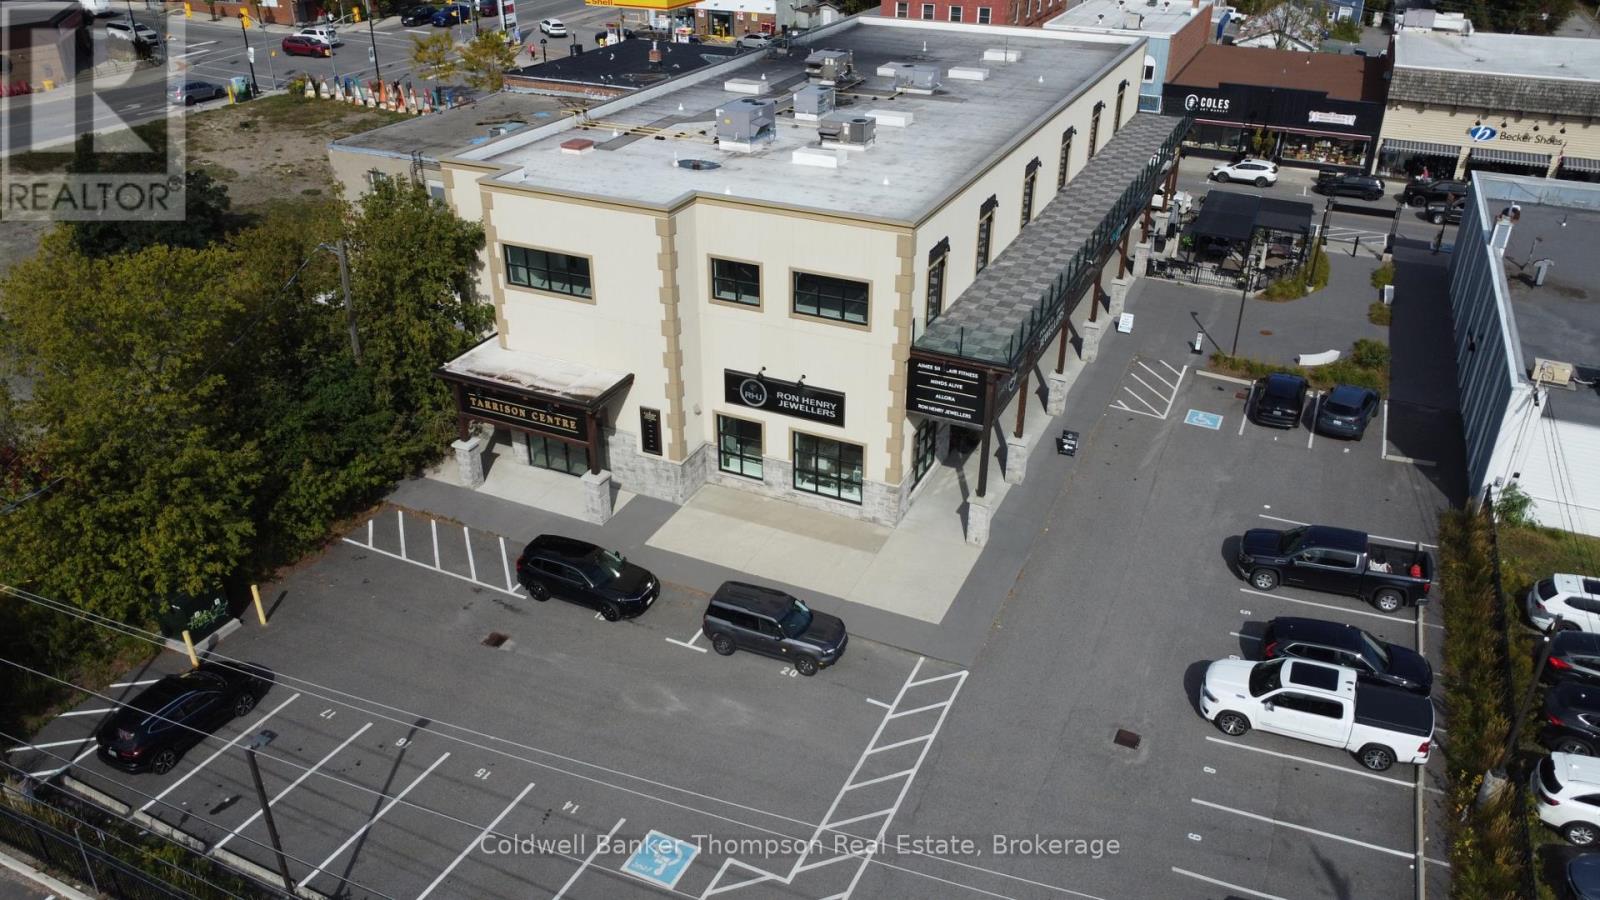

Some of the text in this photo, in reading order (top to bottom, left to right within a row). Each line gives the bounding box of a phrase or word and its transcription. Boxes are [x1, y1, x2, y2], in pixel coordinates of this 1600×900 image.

[1200, 97, 1230, 109] COLES
[1500, 131, 1562, 146] Becker Shoes
[958, 370, 979, 379] FITNESS
[930, 379, 964, 390] MINDS ALIVE
[744, 390, 763, 401] RHJ
[776, 391, 838, 410] RON HENRY
[935, 394, 956, 402] ALLORA
[469, 397, 577, 429] TARRISON CENTRE
[778, 399, 836, 418] JEWELLERS
[928, 405, 945, 414] HENRY
[944, 409, 972, 419] JEWELLERS
[779, 666, 799, 678] 20
[319, 708, 337, 720] 17
[473, 767, 492, 780] 15
[1203, 766, 1217, 774] 8
[562, 800, 580, 814] 14
